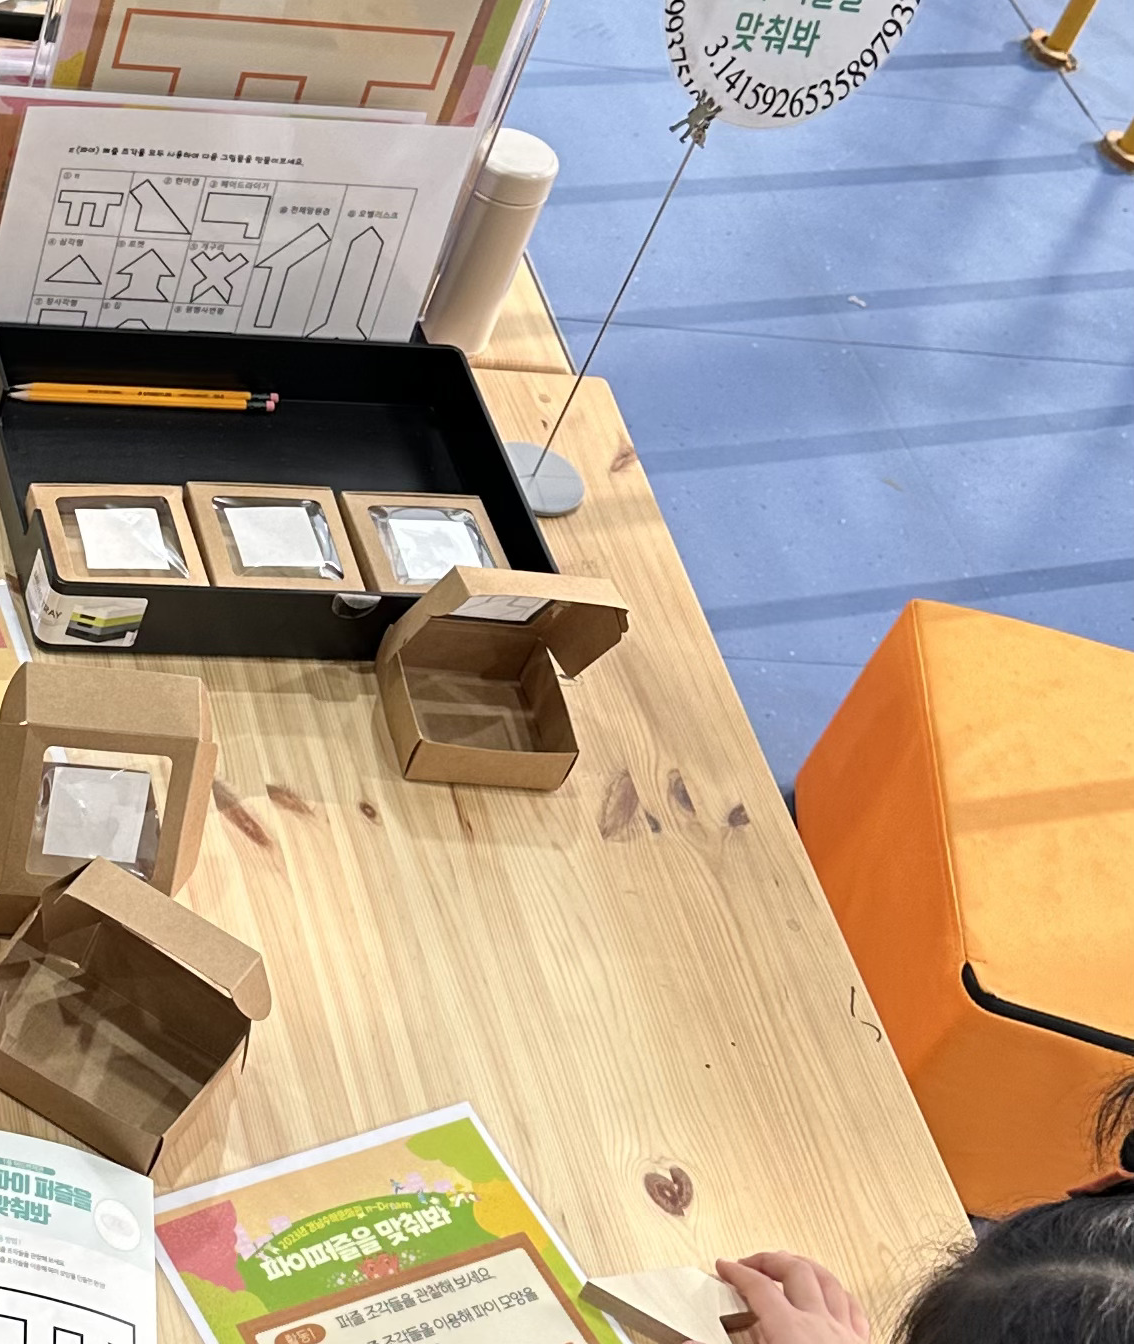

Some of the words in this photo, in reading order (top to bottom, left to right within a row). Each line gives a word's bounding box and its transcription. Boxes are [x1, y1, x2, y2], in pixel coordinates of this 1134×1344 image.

[731, 11, 821, 58] 맞춰봐
[34, 1176, 92, 1212] 퍼즐을
[260, 1226, 382, 1281] 파이퍼즐을
[373, 1206, 453, 1247] 맞춰봐
[335, 1309, 366, 1330] 퍼즐
[366, 1293, 417, 1321] 조각들을
[416, 1279, 456, 1304] 관찰해
[433, 1309, 475, 1333] 이용해
[472, 1299, 502, 1320] 파이
[497, 1286, 540, 1310] 모양을
